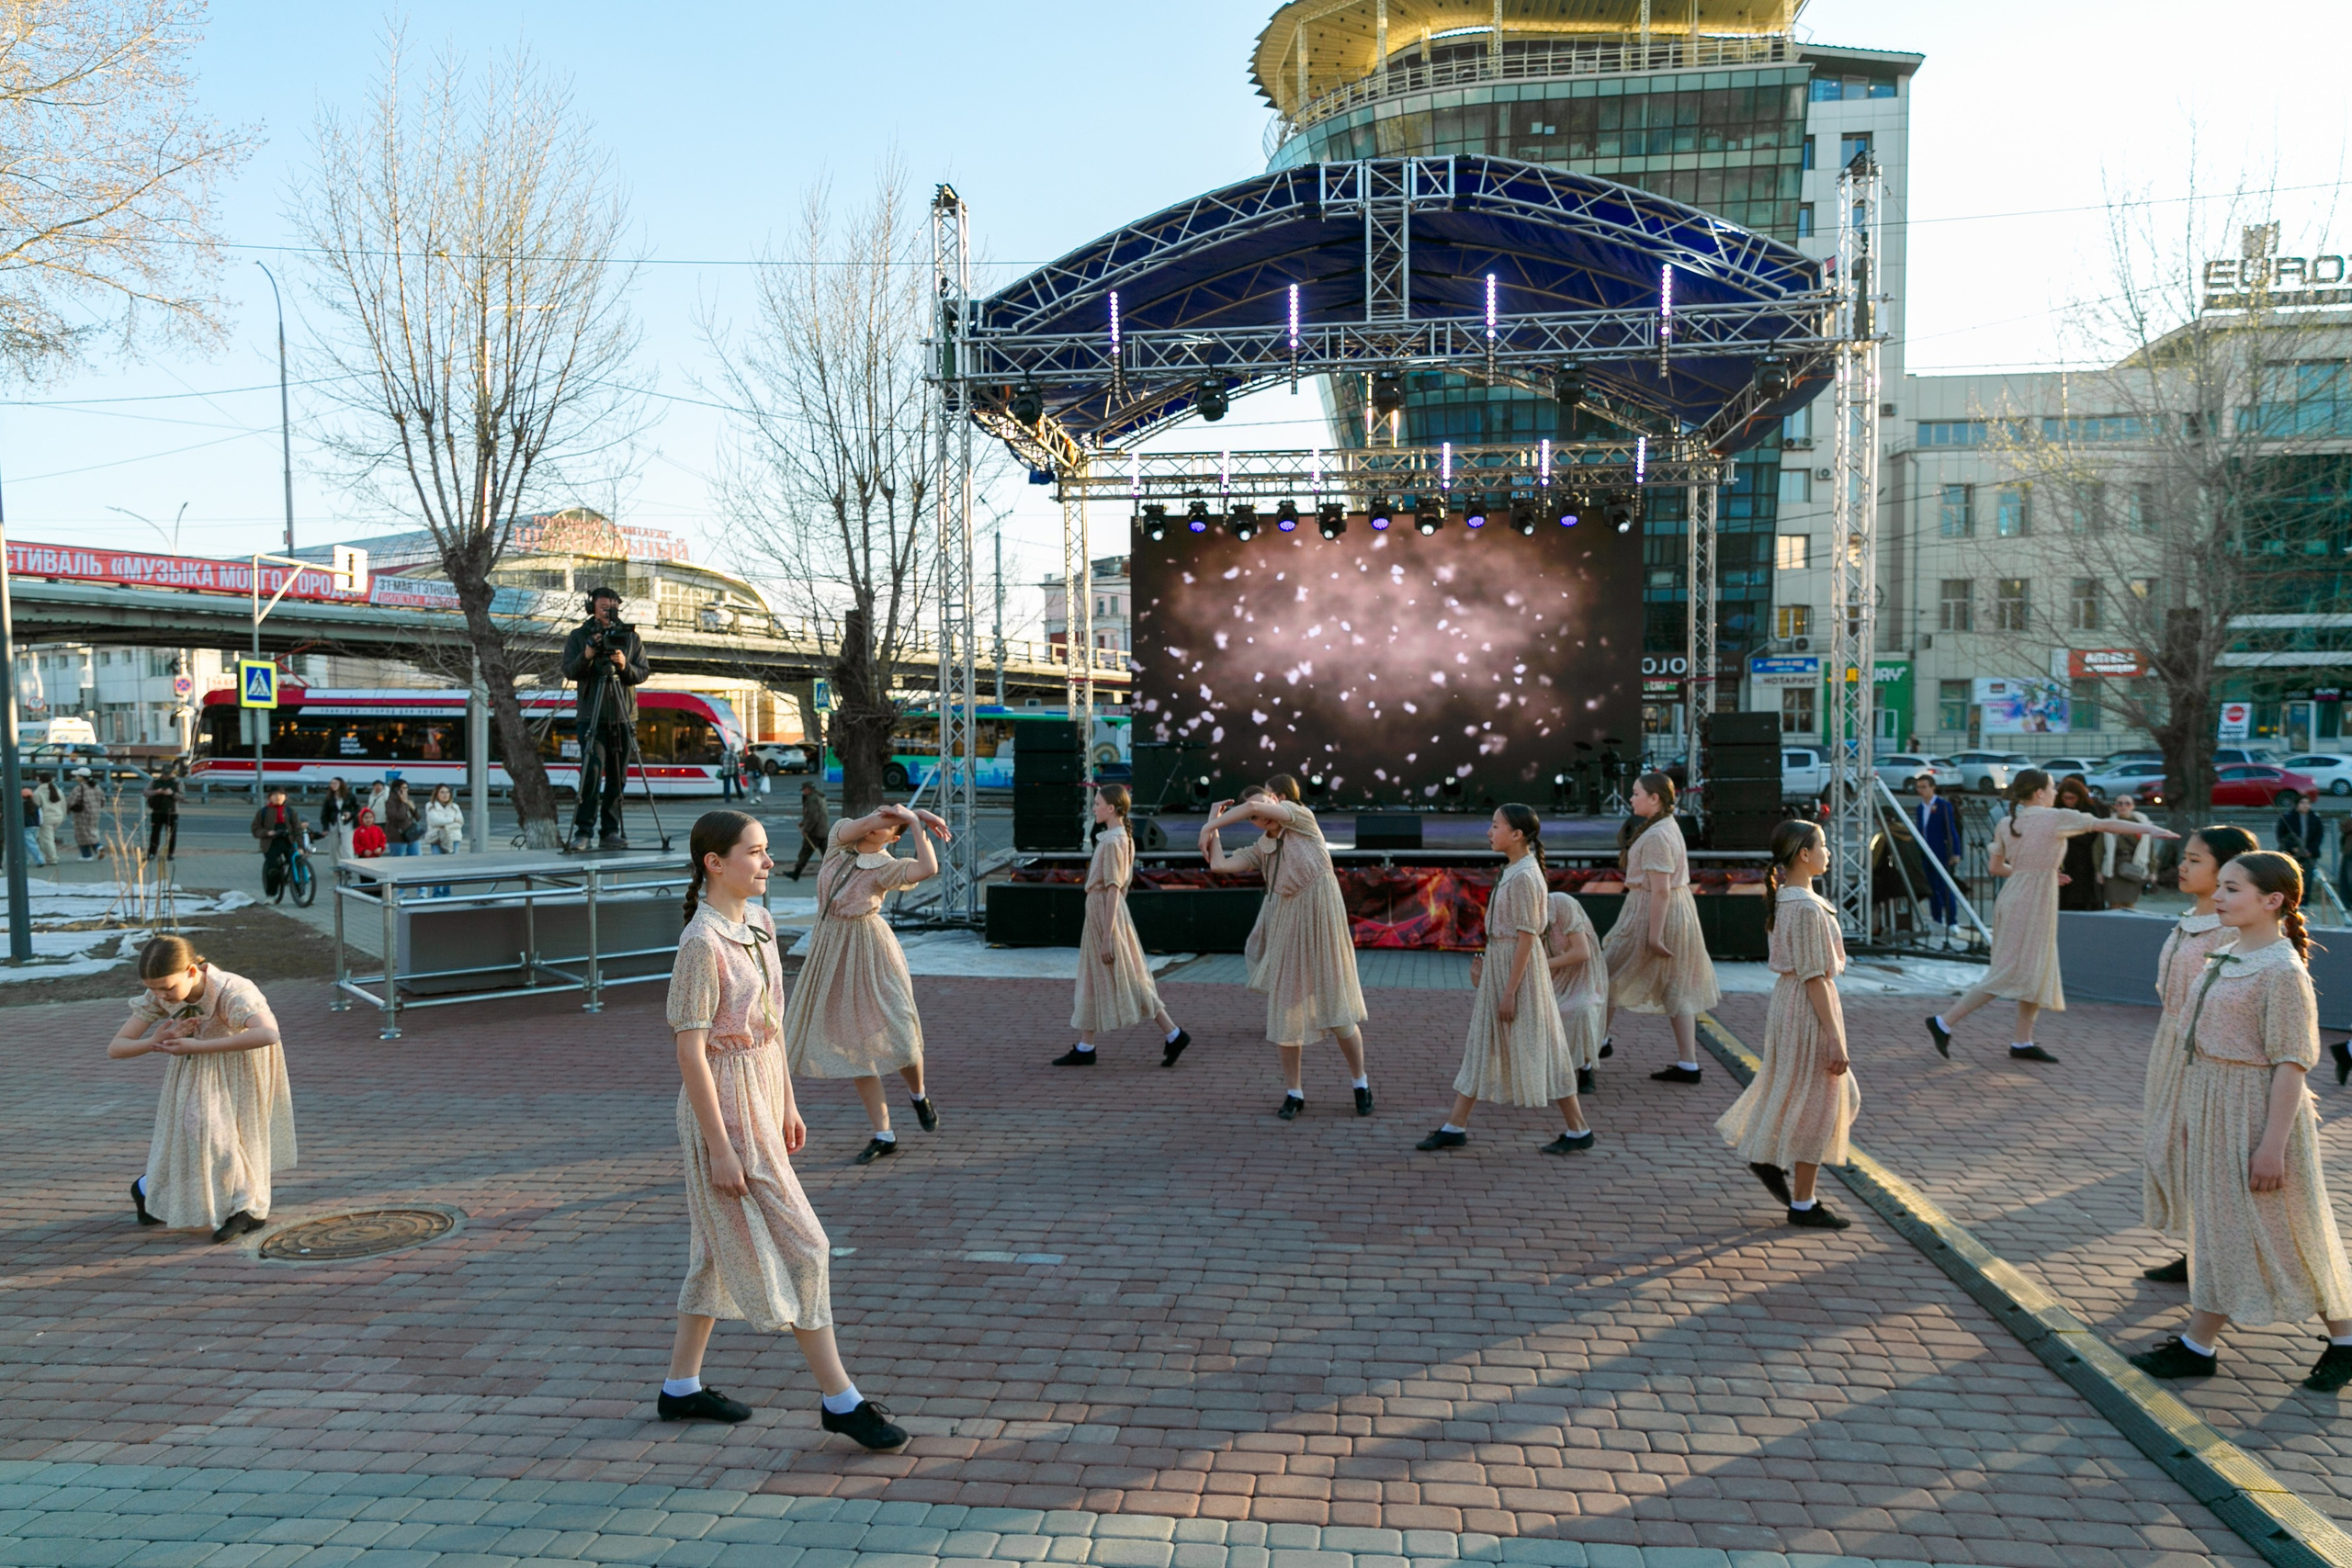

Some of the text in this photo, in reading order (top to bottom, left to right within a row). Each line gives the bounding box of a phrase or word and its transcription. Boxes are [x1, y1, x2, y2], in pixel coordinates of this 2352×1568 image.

[2204, 254, 2352, 287] EURO
[111, 556, 215, 586] «МУЗЫКА
[379, 579, 390, 591] 31
[393, 580, 413, 593] МАЯ
